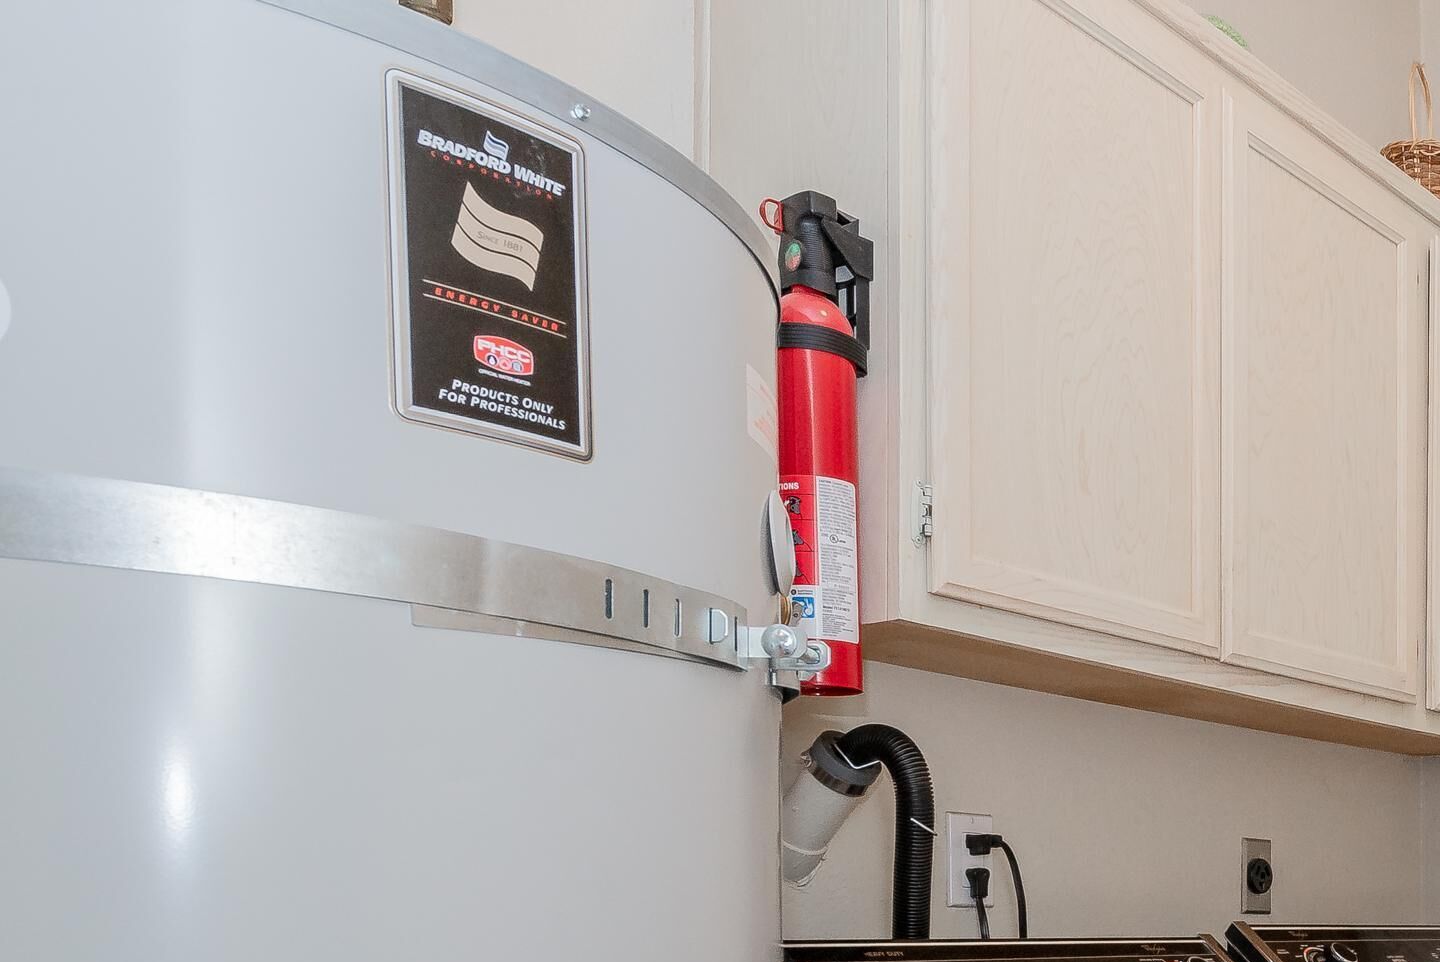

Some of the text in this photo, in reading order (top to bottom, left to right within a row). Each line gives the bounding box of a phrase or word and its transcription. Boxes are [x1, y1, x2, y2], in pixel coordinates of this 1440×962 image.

[417, 129, 566, 196] BRADFORD WHITE
[434, 287, 559, 331] ENERGY SAVER
[477, 339, 531, 362] PHCC
[438, 388, 566, 431] FOR PROFESSIONALS
[452, 379, 554, 414] PRODUCTS ONLY
